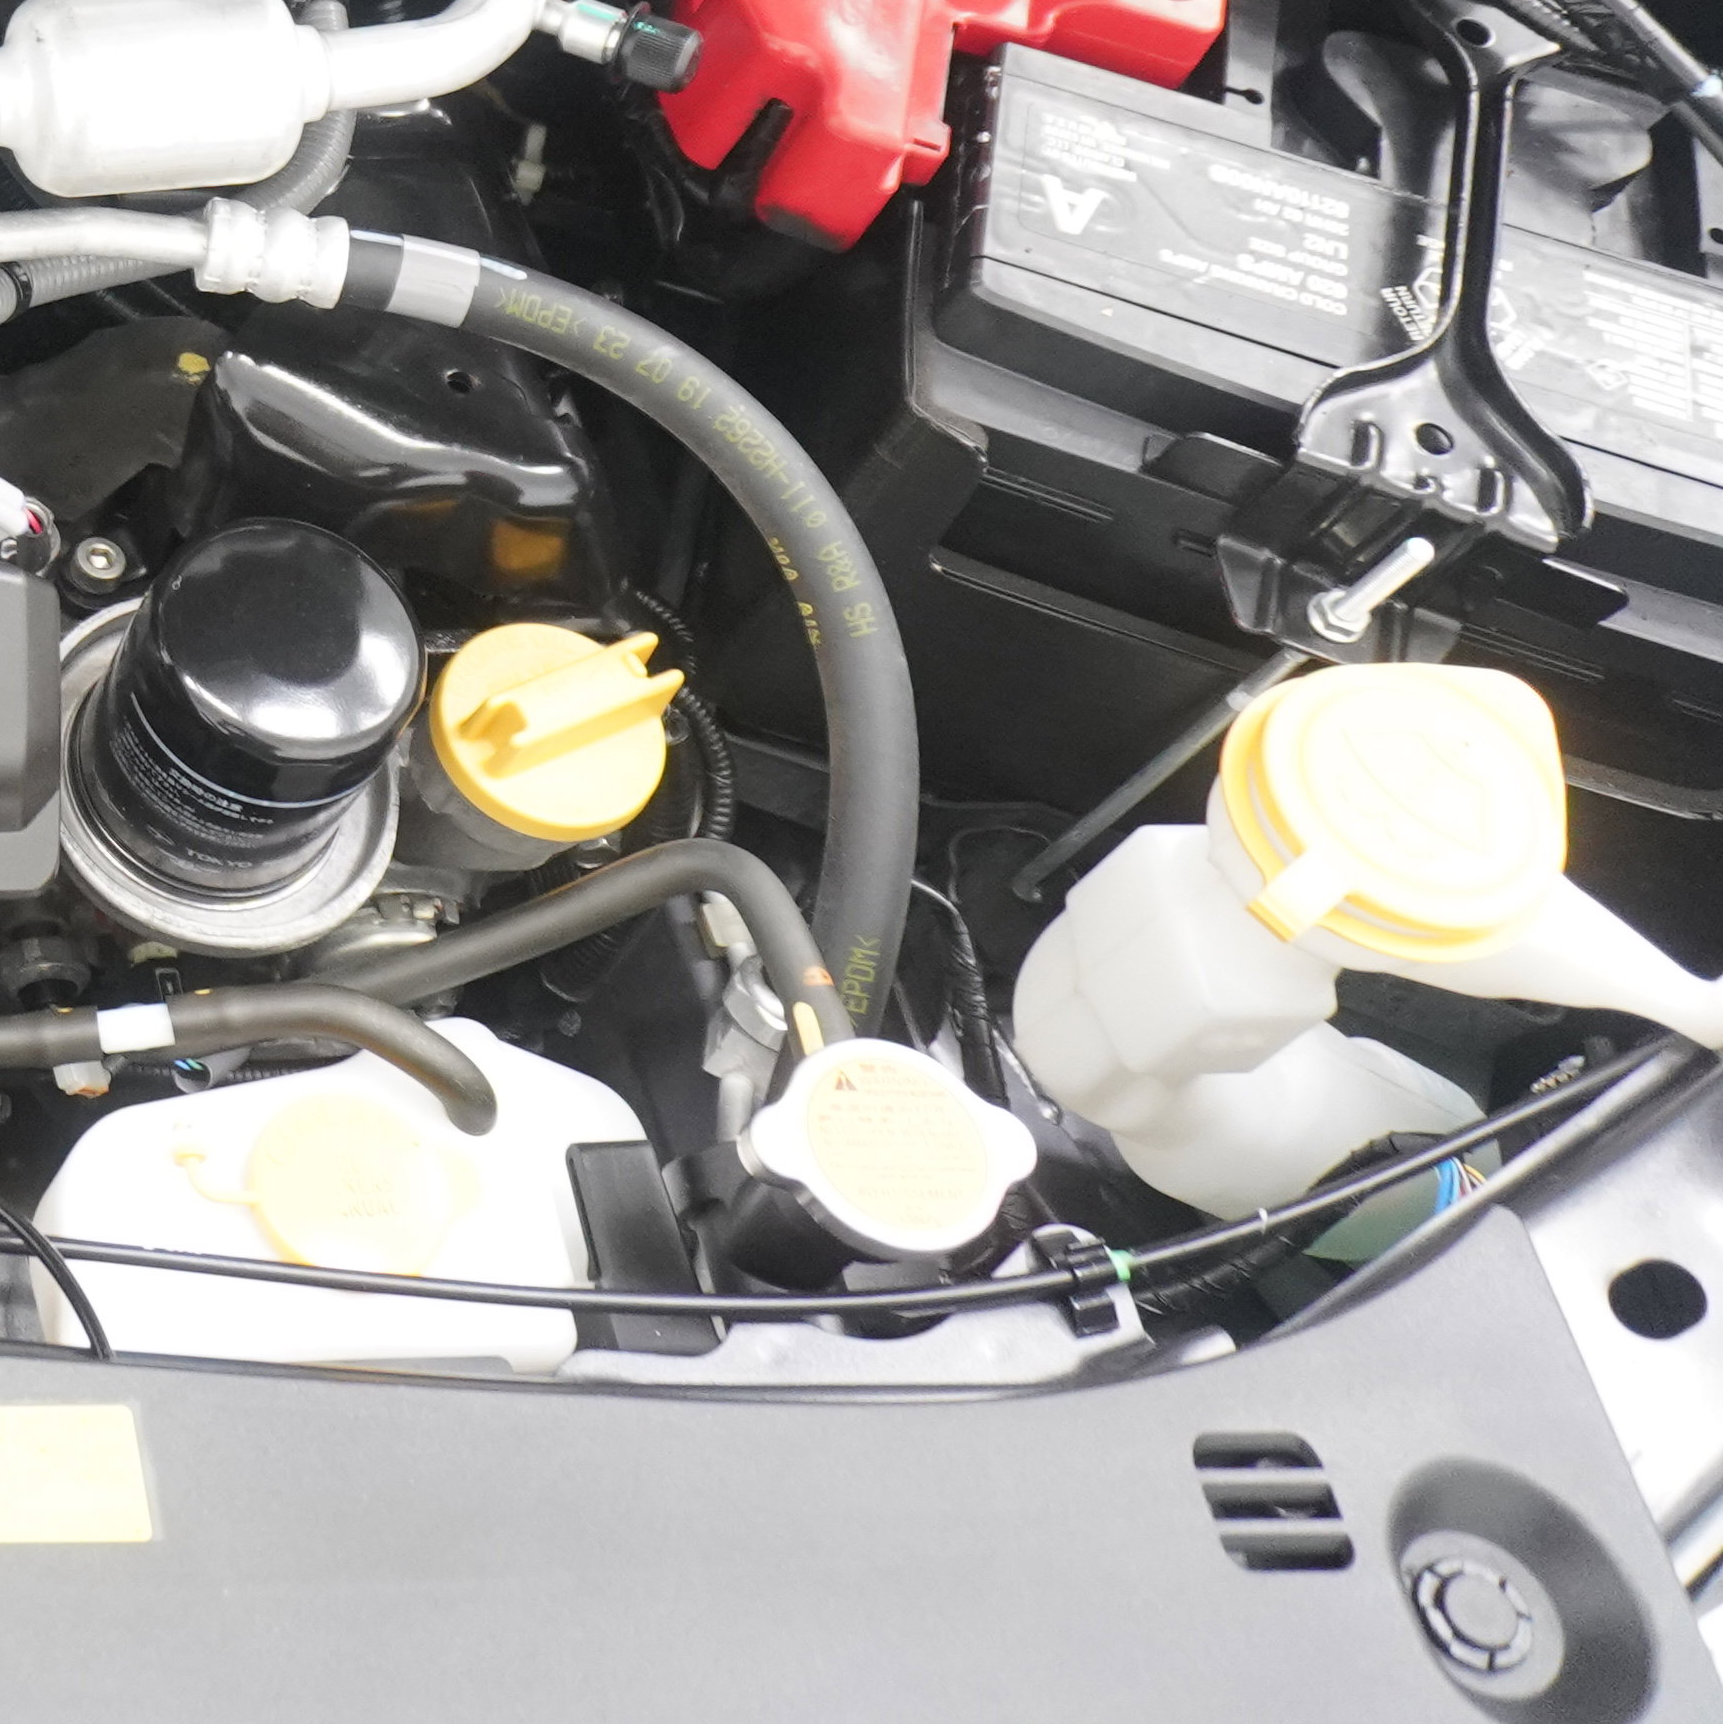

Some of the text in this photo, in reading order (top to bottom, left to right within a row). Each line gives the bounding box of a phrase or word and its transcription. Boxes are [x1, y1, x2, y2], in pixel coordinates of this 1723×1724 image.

[1041, 173, 1111, 236] A
[1287, 249, 1349, 277] GROUP
[1299, 292, 1347, 316] COLD
